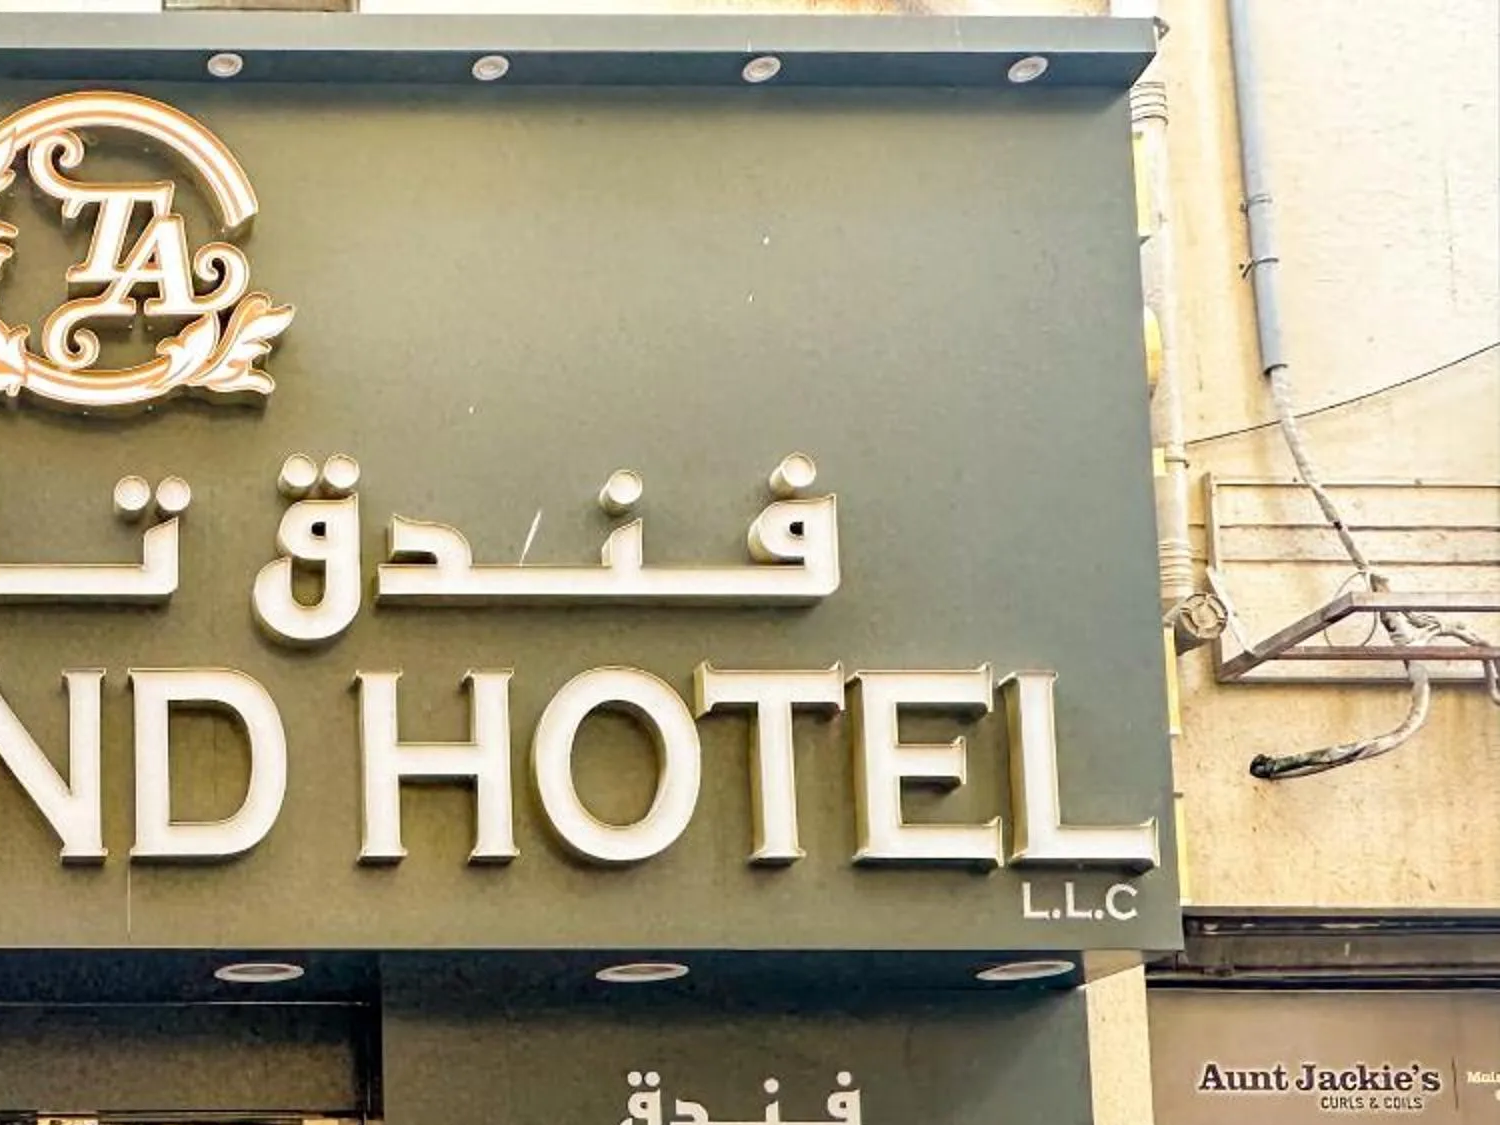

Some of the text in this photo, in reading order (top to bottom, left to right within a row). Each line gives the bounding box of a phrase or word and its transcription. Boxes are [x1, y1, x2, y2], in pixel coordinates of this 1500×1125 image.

[251, 452, 842, 644] فندق
[355, 660, 1162, 872] HOTEL
[1022, 882, 1139, 921] L.L.C
[1199, 1063, 1288, 1092] Aunt
[1295, 1063, 1441, 1092] Jackie's
[1320, 1096, 1364, 1110] CURLS
[1384, 1096, 1423, 1110] COILS
